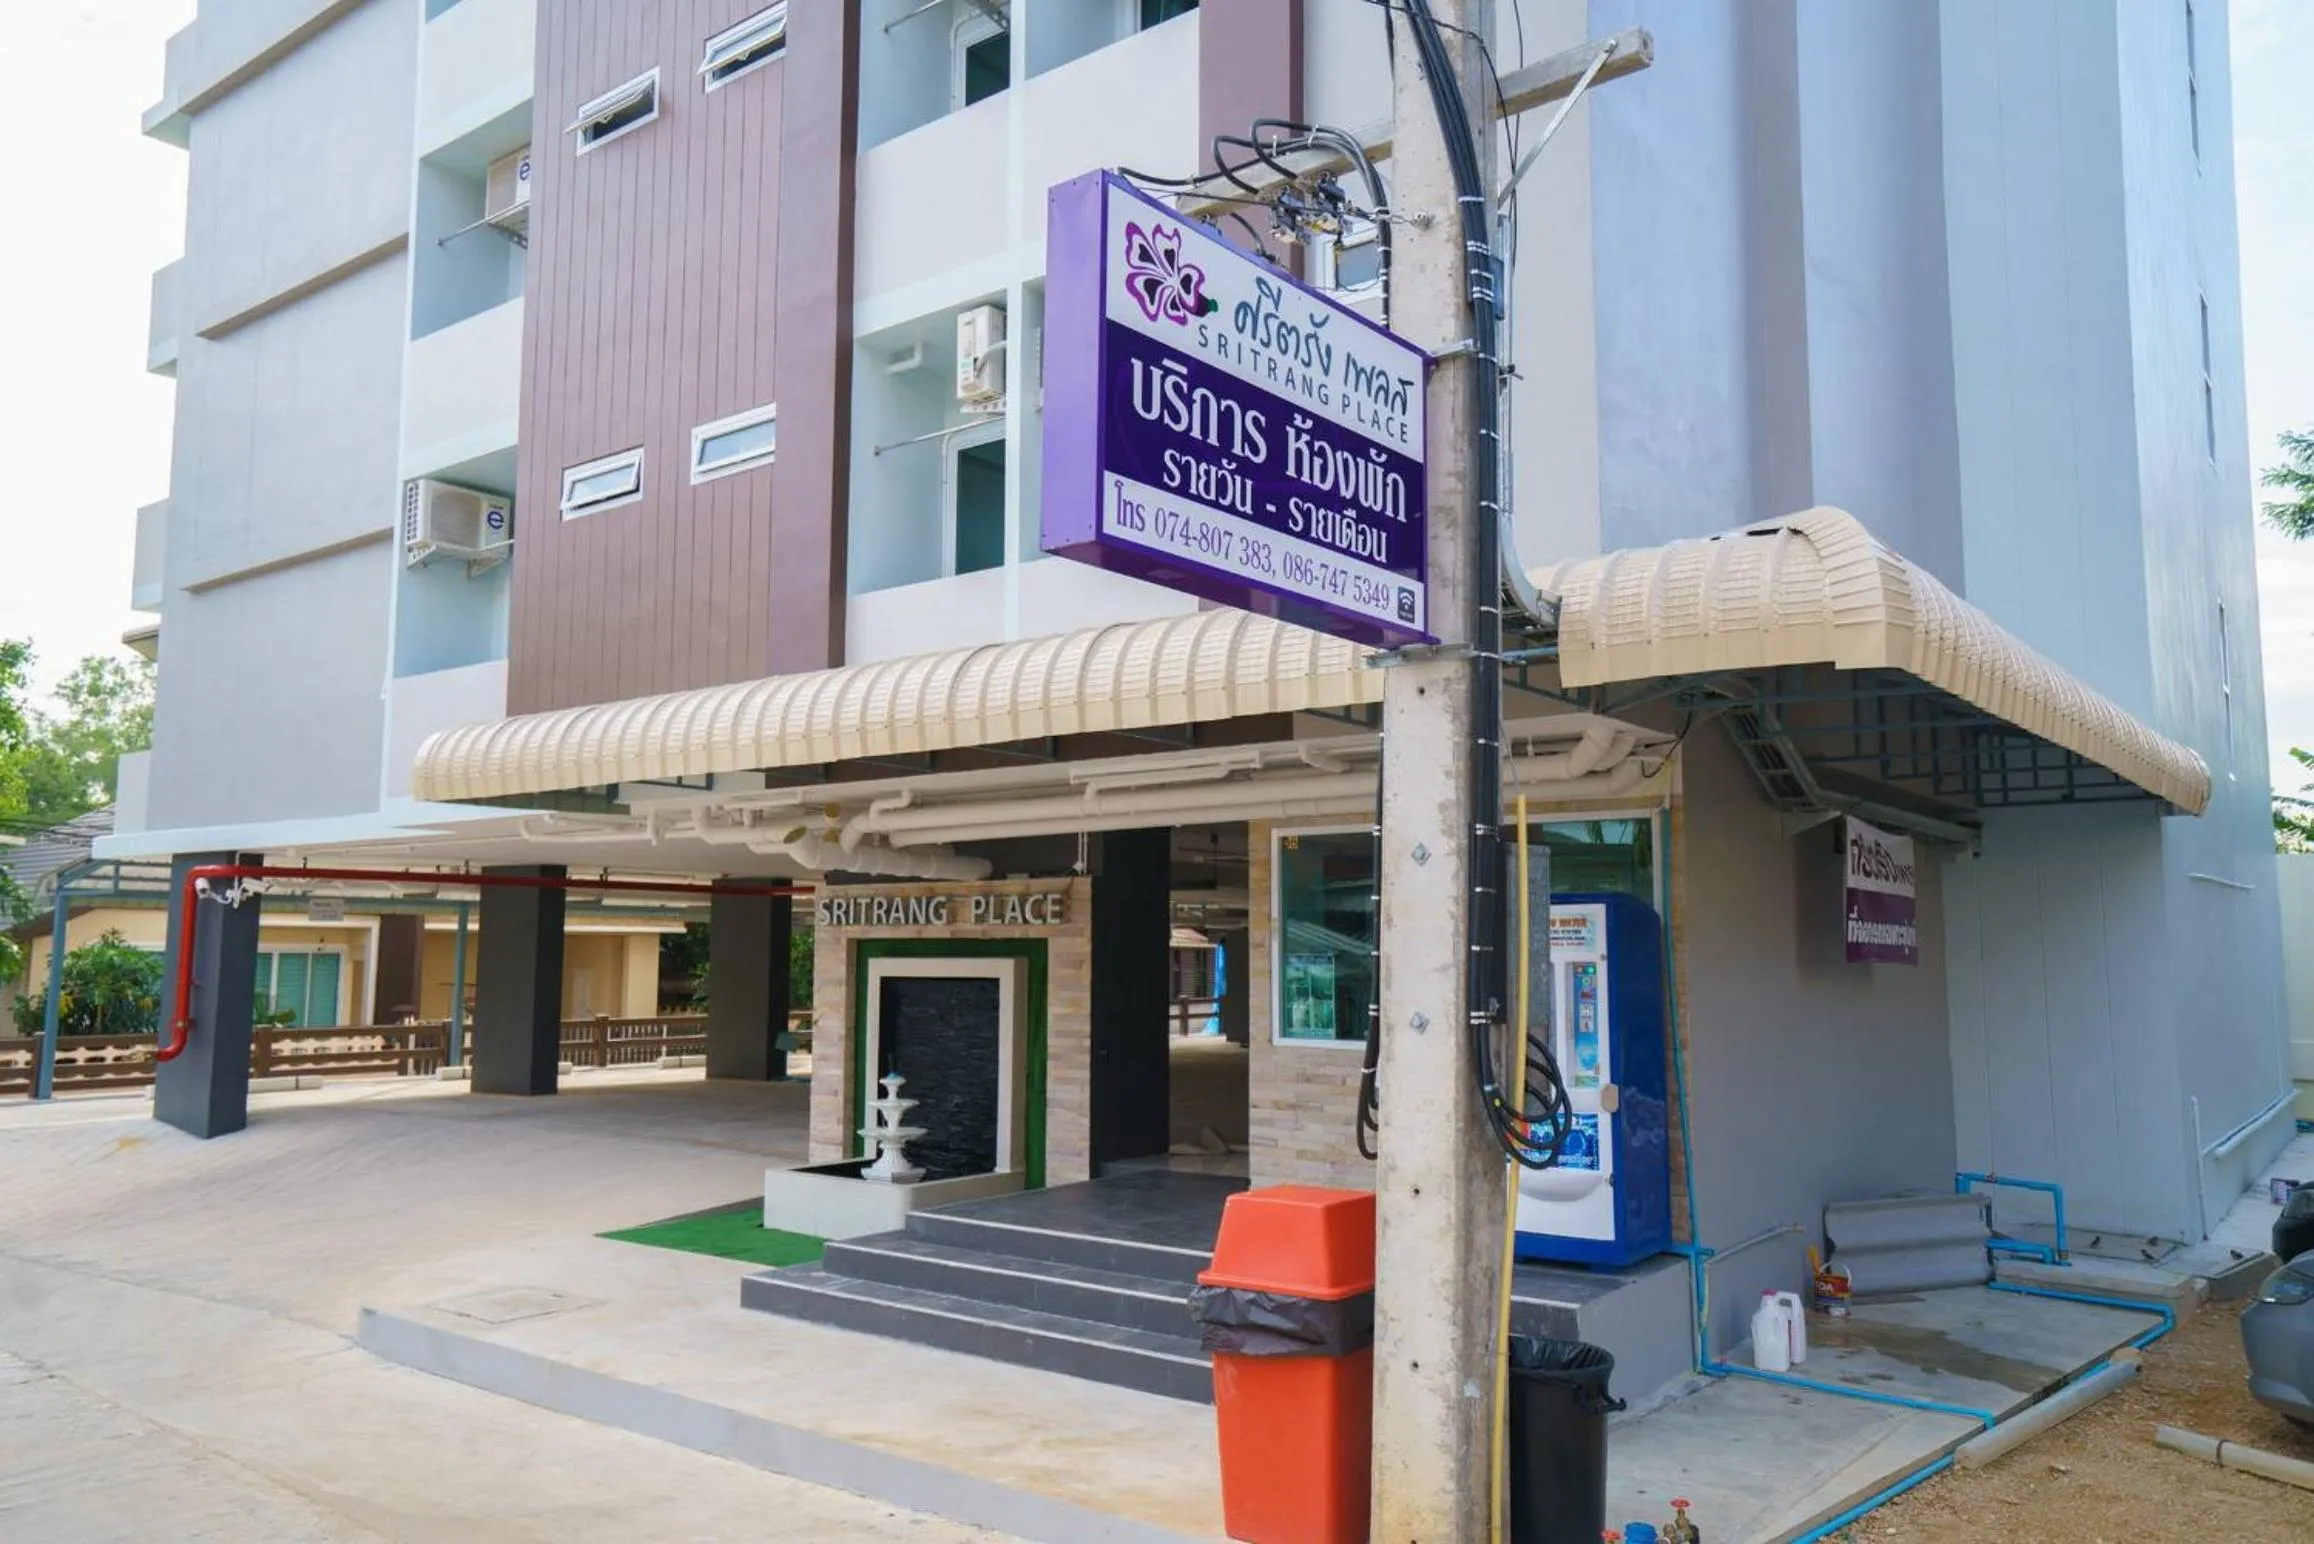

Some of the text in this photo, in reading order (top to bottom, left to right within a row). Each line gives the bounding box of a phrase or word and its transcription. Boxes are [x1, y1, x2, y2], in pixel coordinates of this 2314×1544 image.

[1198, 323, 1409, 443] SRITRANG PLACE
[1234, 276, 1332, 377] ศรีตรัง
[1130, 357, 1407, 524] บริการ ห้องพัก
[1114, 479, 1146, 532] โทร
[1154, 507, 1233, 561] 074-807
[1282, 551, 1349, 597] 086-747
[1353, 575, 1390, 610] 5349
[1162, 448, 1254, 515] รายวัน
[1288, 496, 1388, 564] รายเดือน
[818, 893, 1062, 926] SRITRANG PLACE
